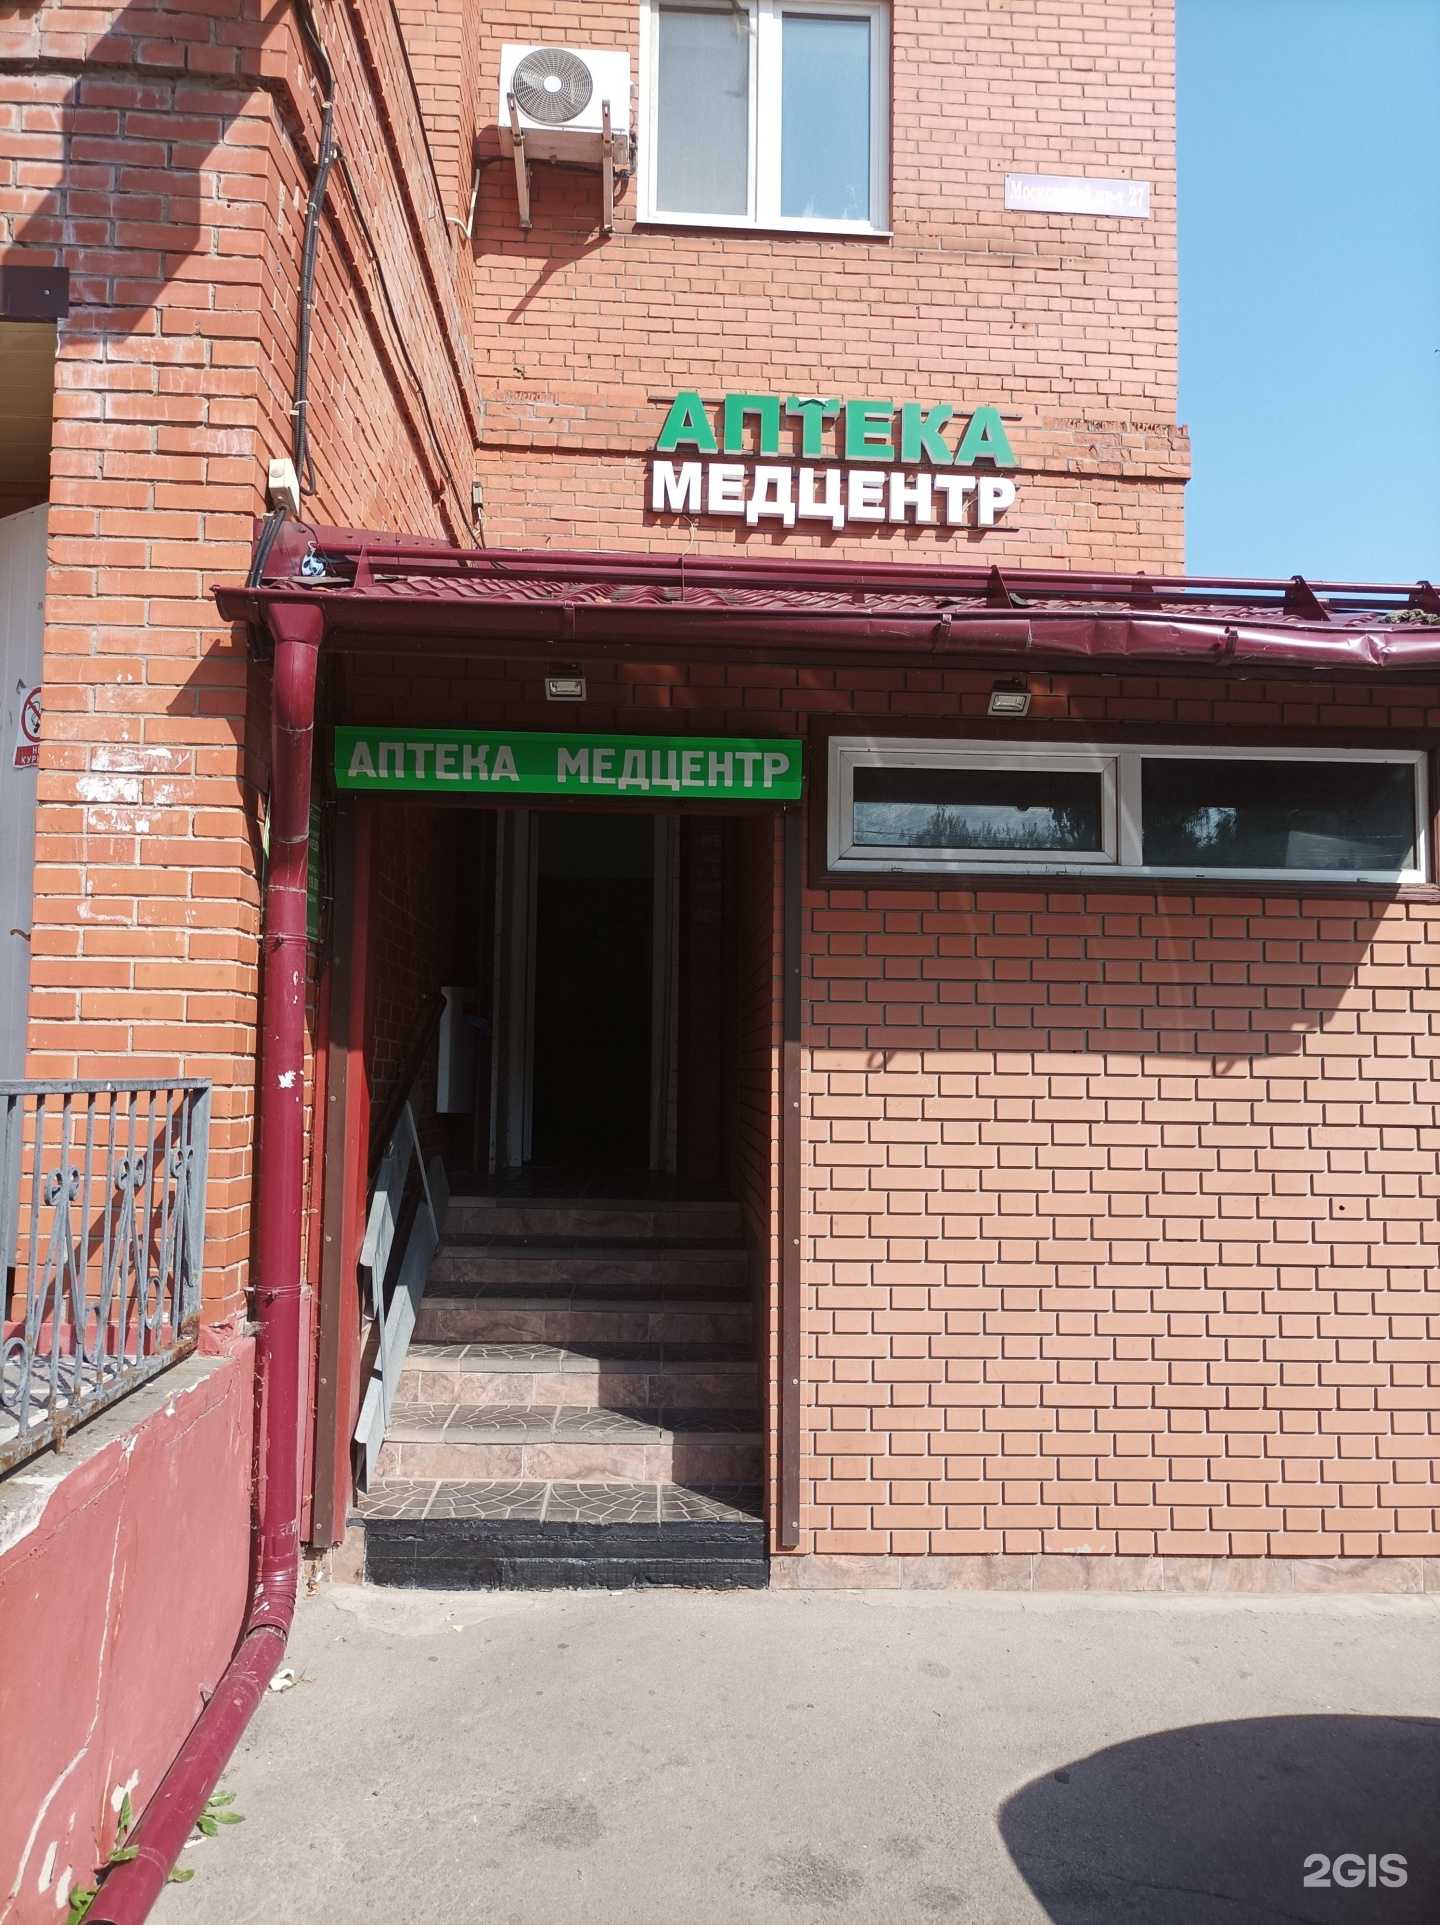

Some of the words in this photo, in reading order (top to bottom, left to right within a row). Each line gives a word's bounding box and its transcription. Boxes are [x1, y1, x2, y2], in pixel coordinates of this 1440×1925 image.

[1128, 185, 1146, 209] 27
[656, 391, 1018, 467] АПТЕКА
[652, 460, 1017, 530] МЕДЦЕНТР
[348, 741, 520, 781] АПТЕКА
[557, 747, 790, 791] МЕДЦЕНТР
